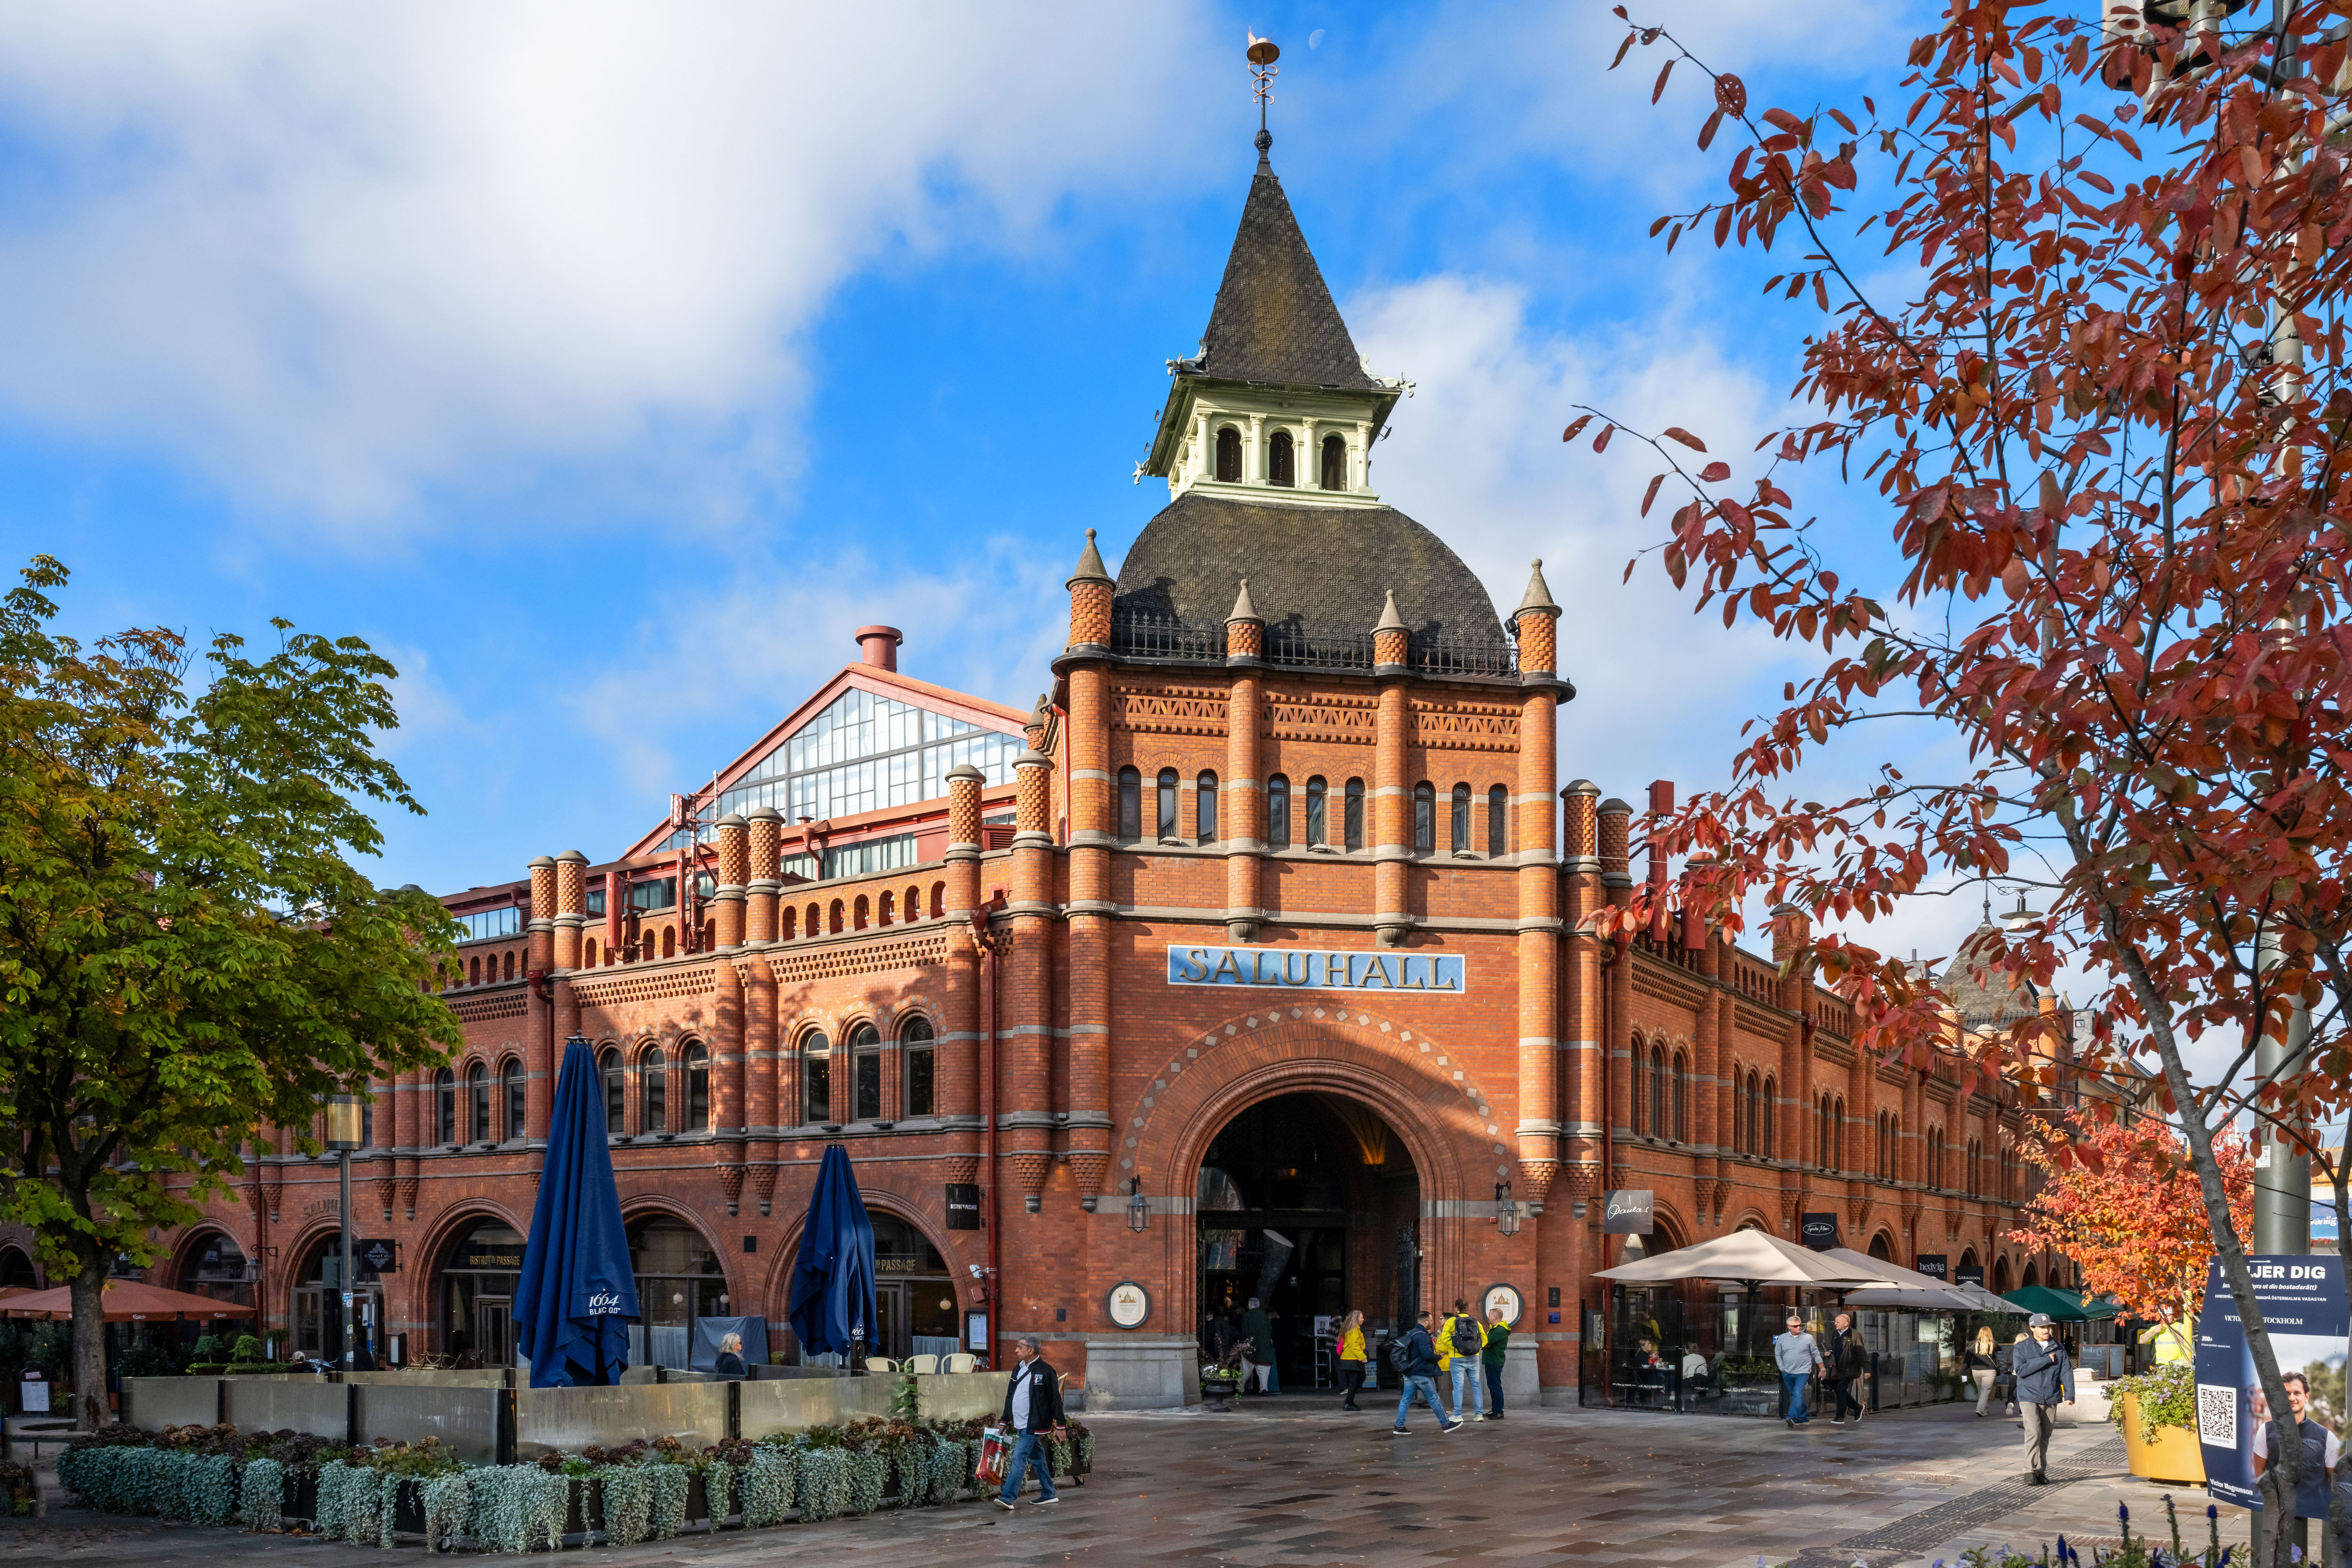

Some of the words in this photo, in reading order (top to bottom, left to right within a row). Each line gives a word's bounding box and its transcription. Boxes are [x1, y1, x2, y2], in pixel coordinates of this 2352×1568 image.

[1179, 949, 1455, 989] SALUHALL
[470, 1256, 491, 1265] BISTROT
[496, 1256, 520, 1265] PASSAGE
[881, 1259, 916, 1271] PASSAGE
[1919, 1263, 1944, 1273] hedvig
[2290, 1266, 2326, 1279] DIG
[589, 1293, 620, 1307] 1664
[589, 1307, 607, 1315] BLAC
[851, 1327, 865, 1336] 166
[2209, 1478, 2224, 1488] Victor
[2224, 1482, 2253, 1496] Magnusson
